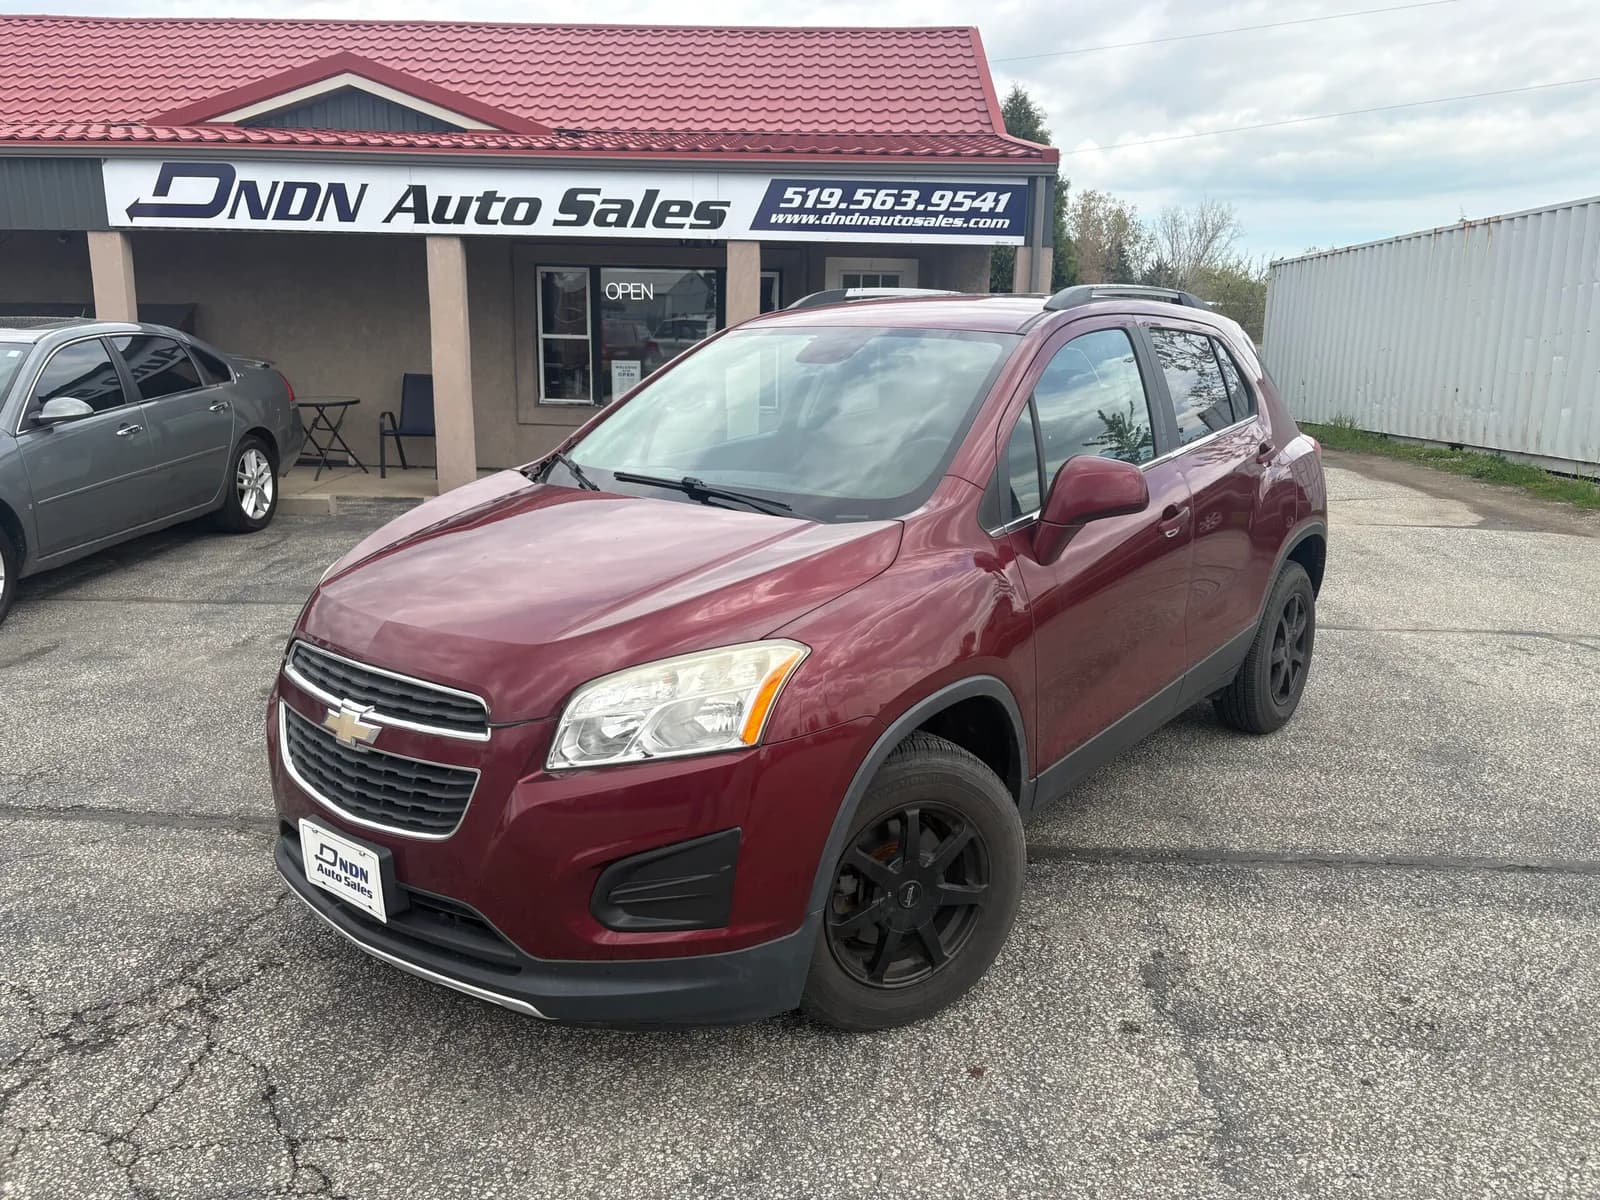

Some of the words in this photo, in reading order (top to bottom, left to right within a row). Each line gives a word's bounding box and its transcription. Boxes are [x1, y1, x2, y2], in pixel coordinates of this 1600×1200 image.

[125, 162, 369, 223] DNDN
[382, 184, 542, 226] Auto
[552, 187, 731, 229] Sales
[779, 187, 1012, 212] 519.563.9541
[770, 212, 1011, 229] www.dndnautosales.com
[605, 282, 654, 301] OPEN
[314, 843, 369, 884] DNDN
[316, 863, 342, 883] Auto
[344, 876, 373, 899] Sales
